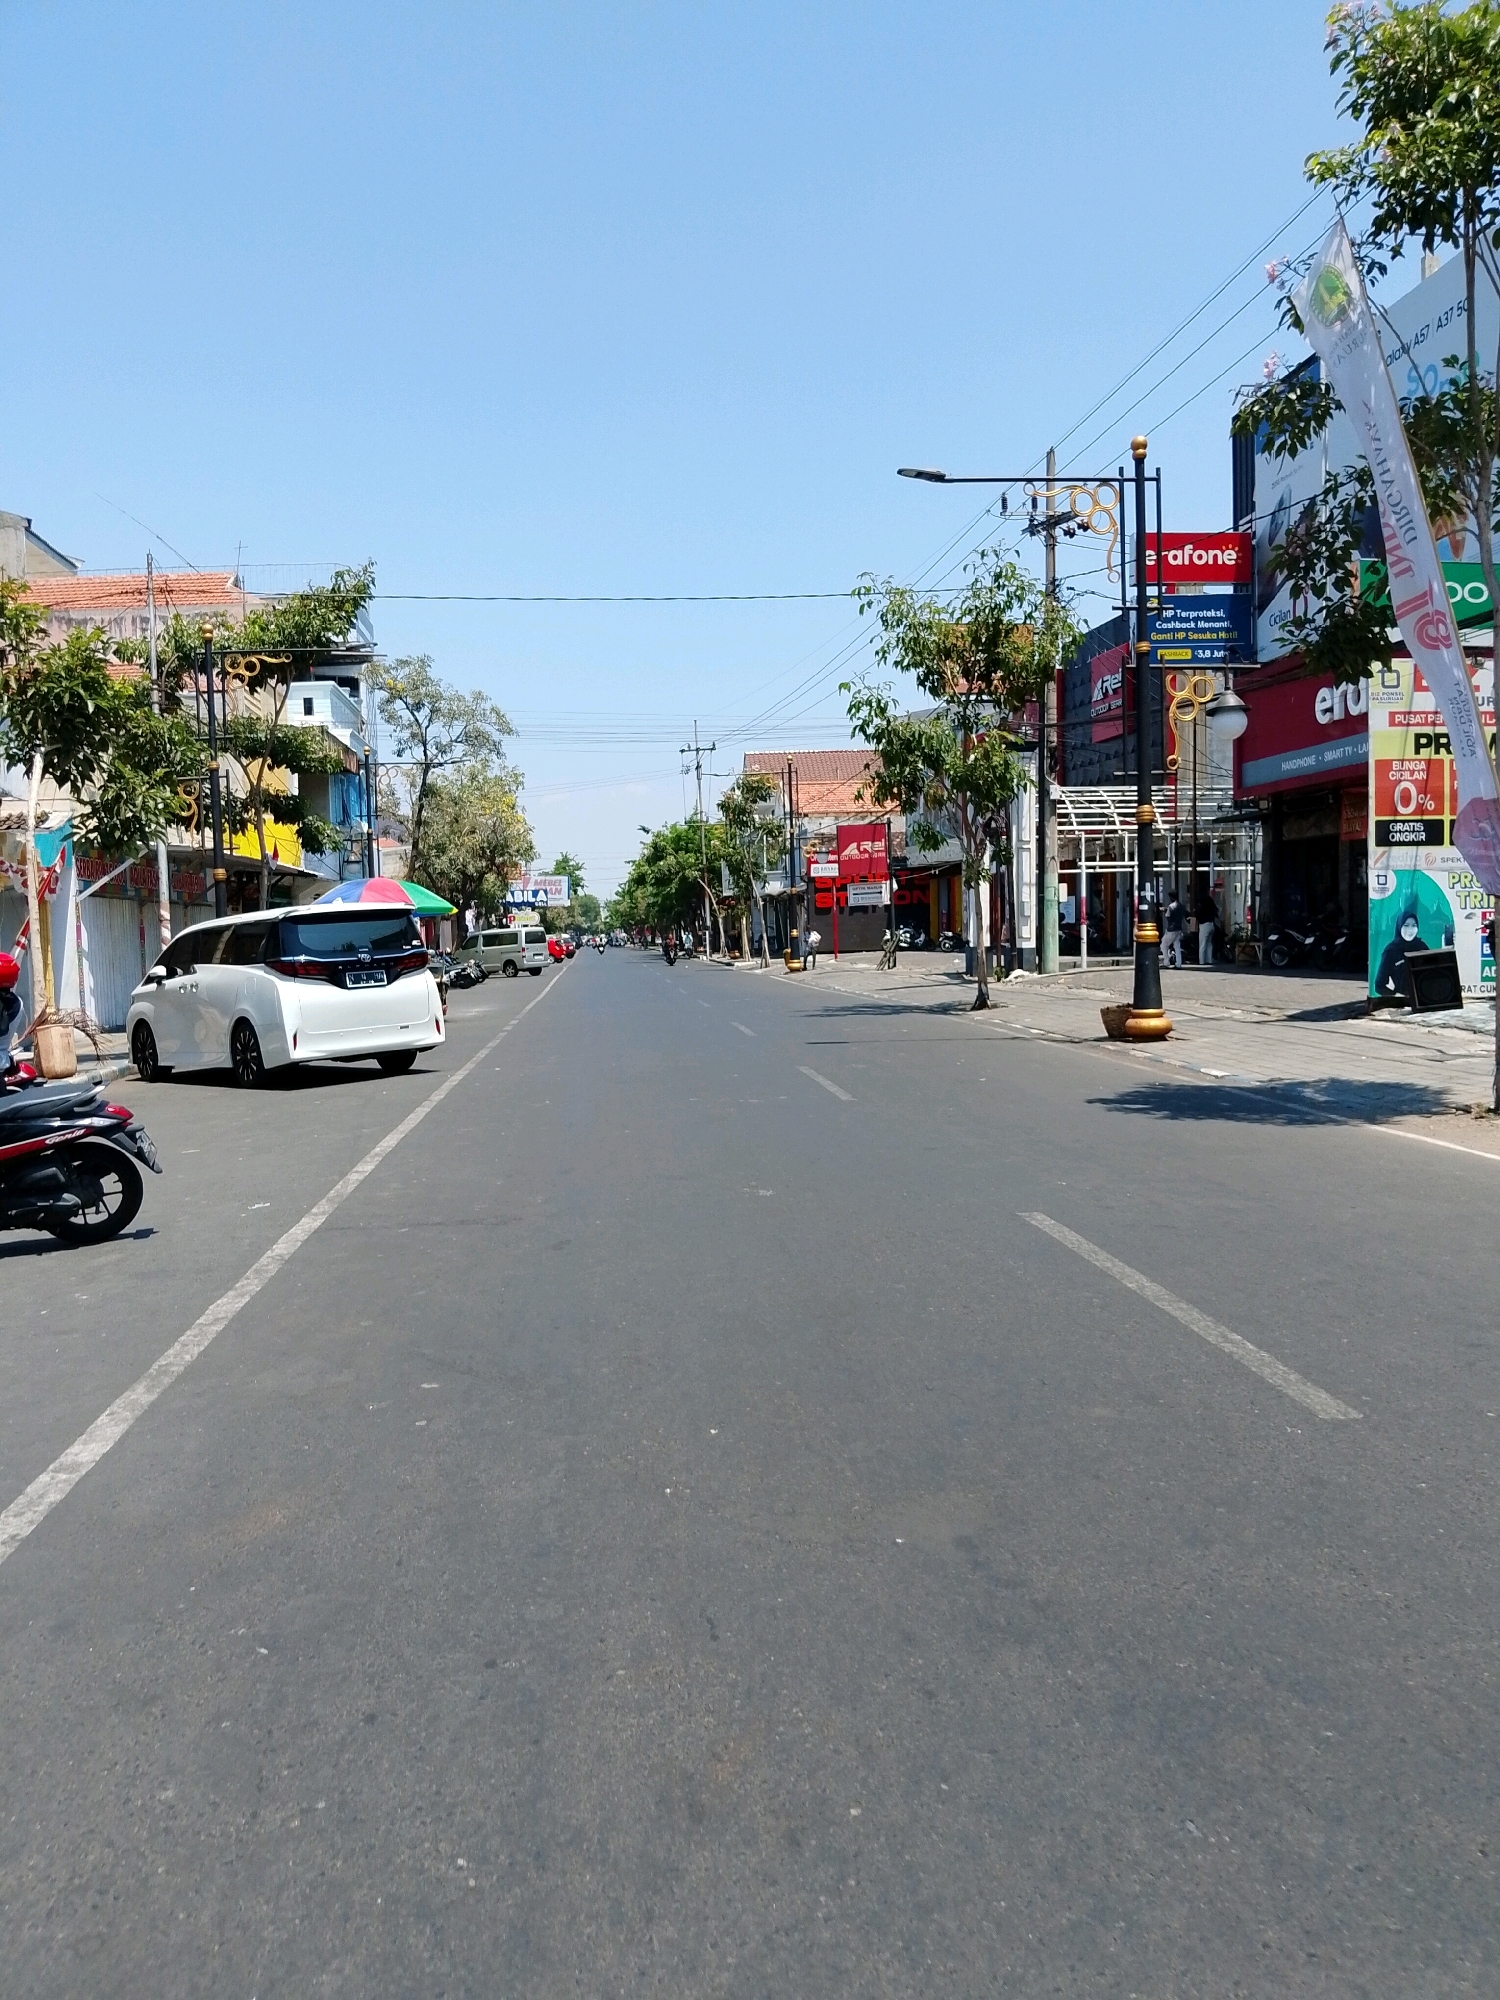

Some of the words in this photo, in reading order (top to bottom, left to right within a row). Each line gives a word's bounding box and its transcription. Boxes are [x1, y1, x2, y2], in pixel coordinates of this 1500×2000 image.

[1386, 339, 1412, 367] alaxy
[1413, 325, 1430, 349] A57
[1436, 306, 1454, 332] A37
[1163, 609, 1175, 618] HP
[1176, 609, 1225, 619] Terproteksi,
[1269, 609, 1291, 627] Cicilan
[1156, 620, 1195, 628] Cashback
[1198, 620, 1232, 628] Menanti,
[1150, 631, 1173, 640] Ganti
[1188, 631, 1217, 639] Sesuka
[1395, 714, 1427, 724] PUSAT
[1281, 755, 1316, 771] HANDPHONE
[1323, 748, 1344, 763] SMART
[1392, 761, 1427, 770] BUNGA
[1389, 771, 1427, 780] CICILAN
[1389, 823, 1424, 832] GRATIS
[1389, 832, 1426, 842] ONGKIR
[506, 890, 547, 902] ABILA
